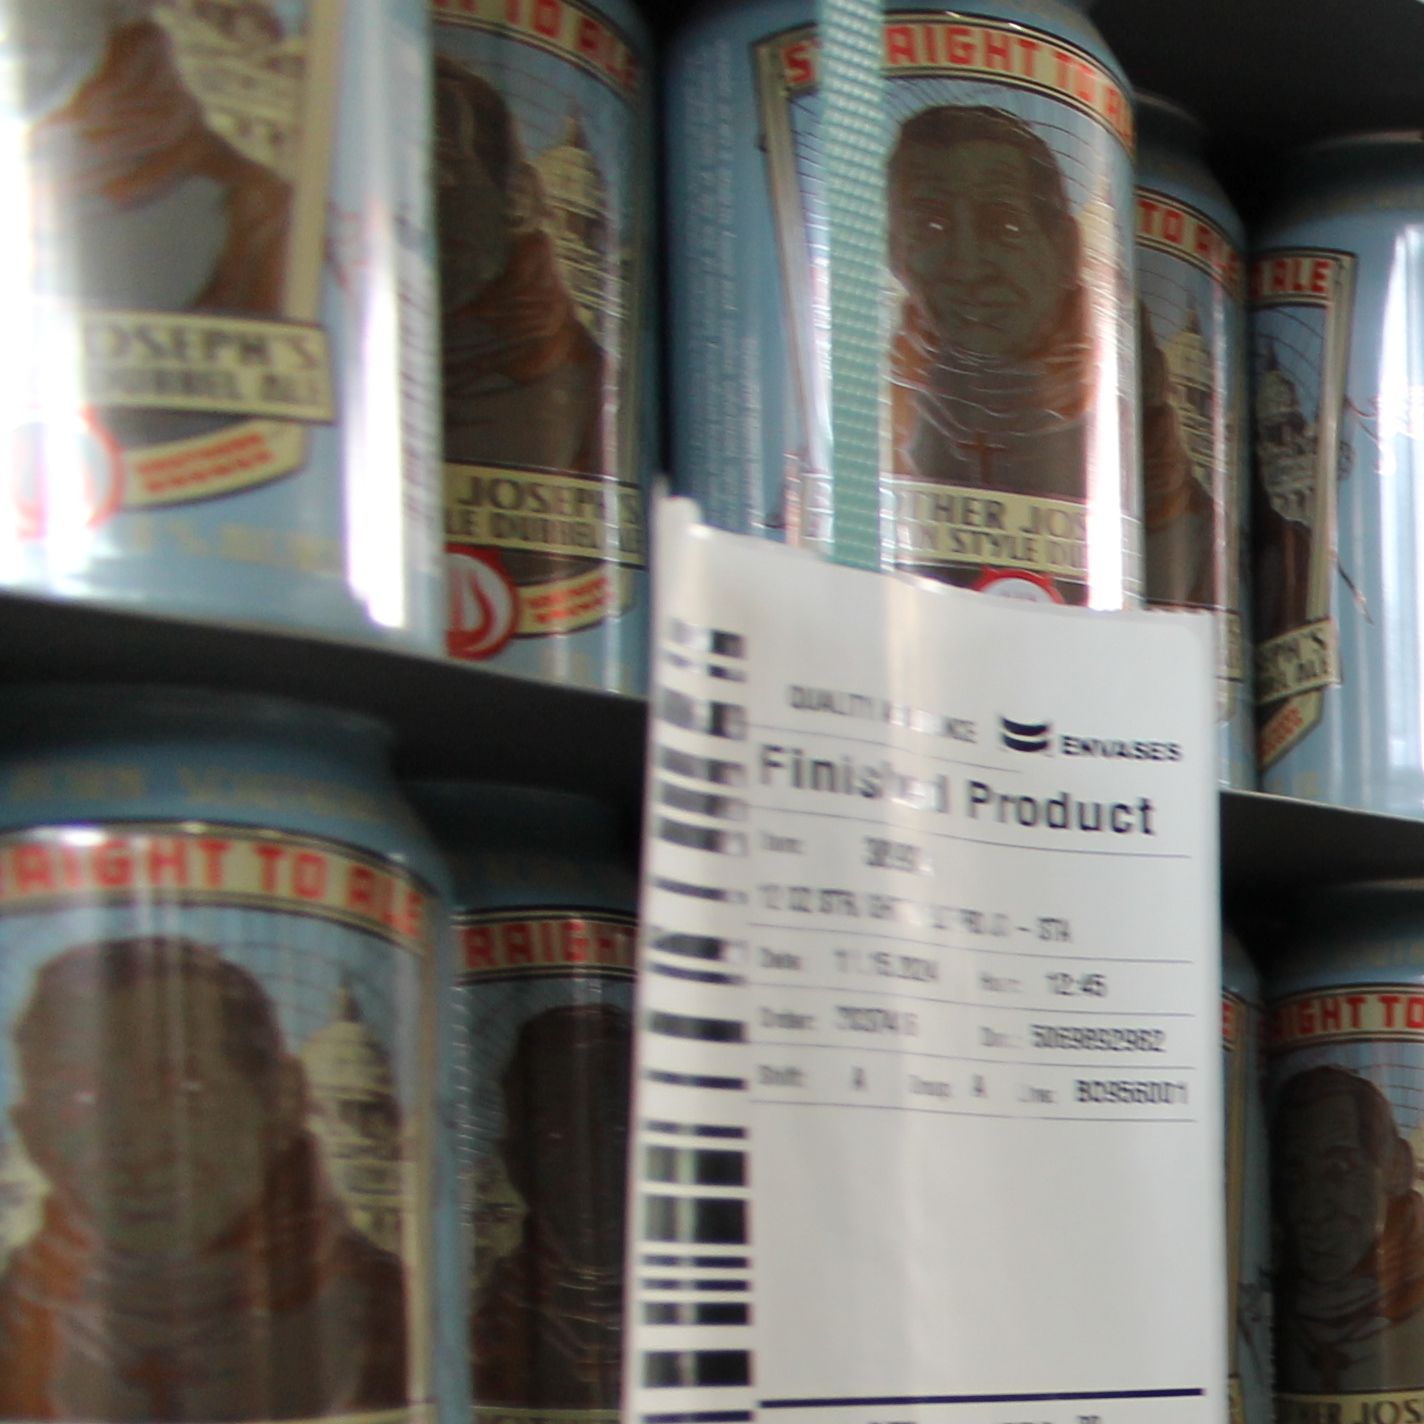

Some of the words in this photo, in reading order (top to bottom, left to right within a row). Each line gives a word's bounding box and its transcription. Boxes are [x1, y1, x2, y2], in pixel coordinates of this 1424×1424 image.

[783, 22, 1038, 84] SAIGHT
[1061, 734, 1184, 763] ENVASES
[966, 779, 1158, 837] Product
[254, 844, 329, 899] TO
